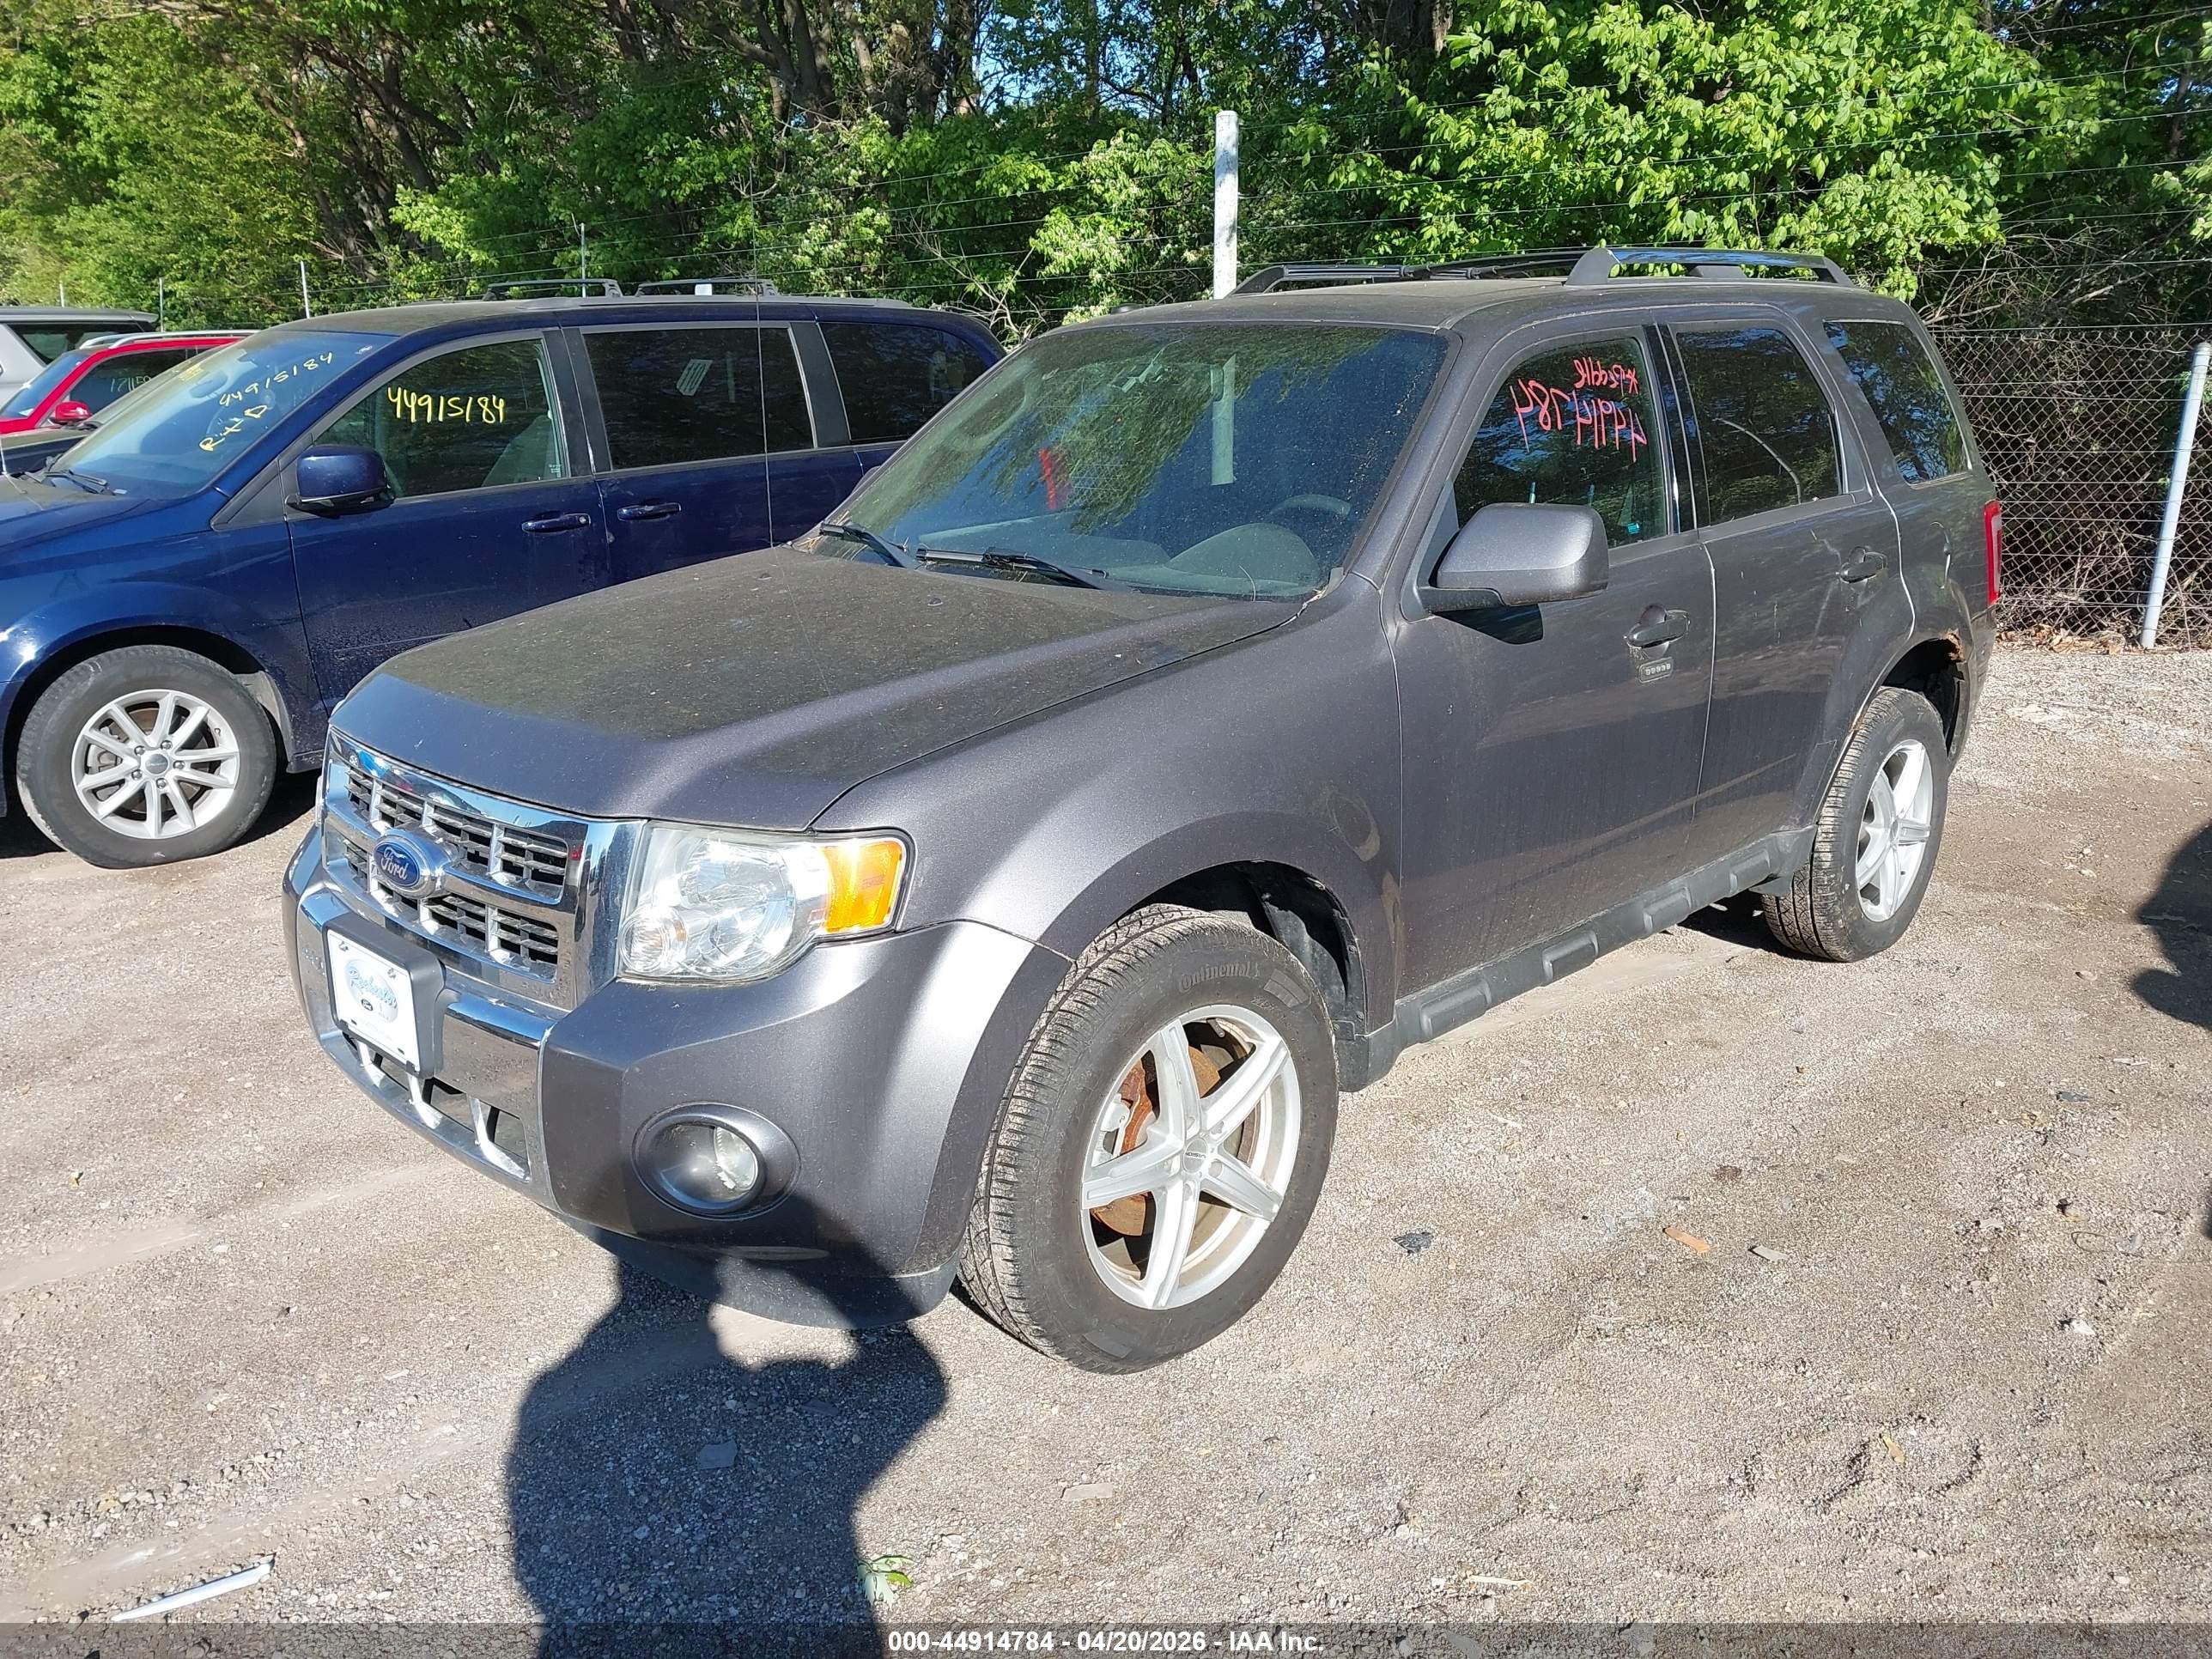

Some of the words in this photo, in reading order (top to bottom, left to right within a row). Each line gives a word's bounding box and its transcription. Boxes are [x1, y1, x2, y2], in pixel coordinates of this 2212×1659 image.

[219, 352, 333, 406] 44915184
[387, 386, 505, 424] 44915184
[380, 846, 410, 880] Ford
